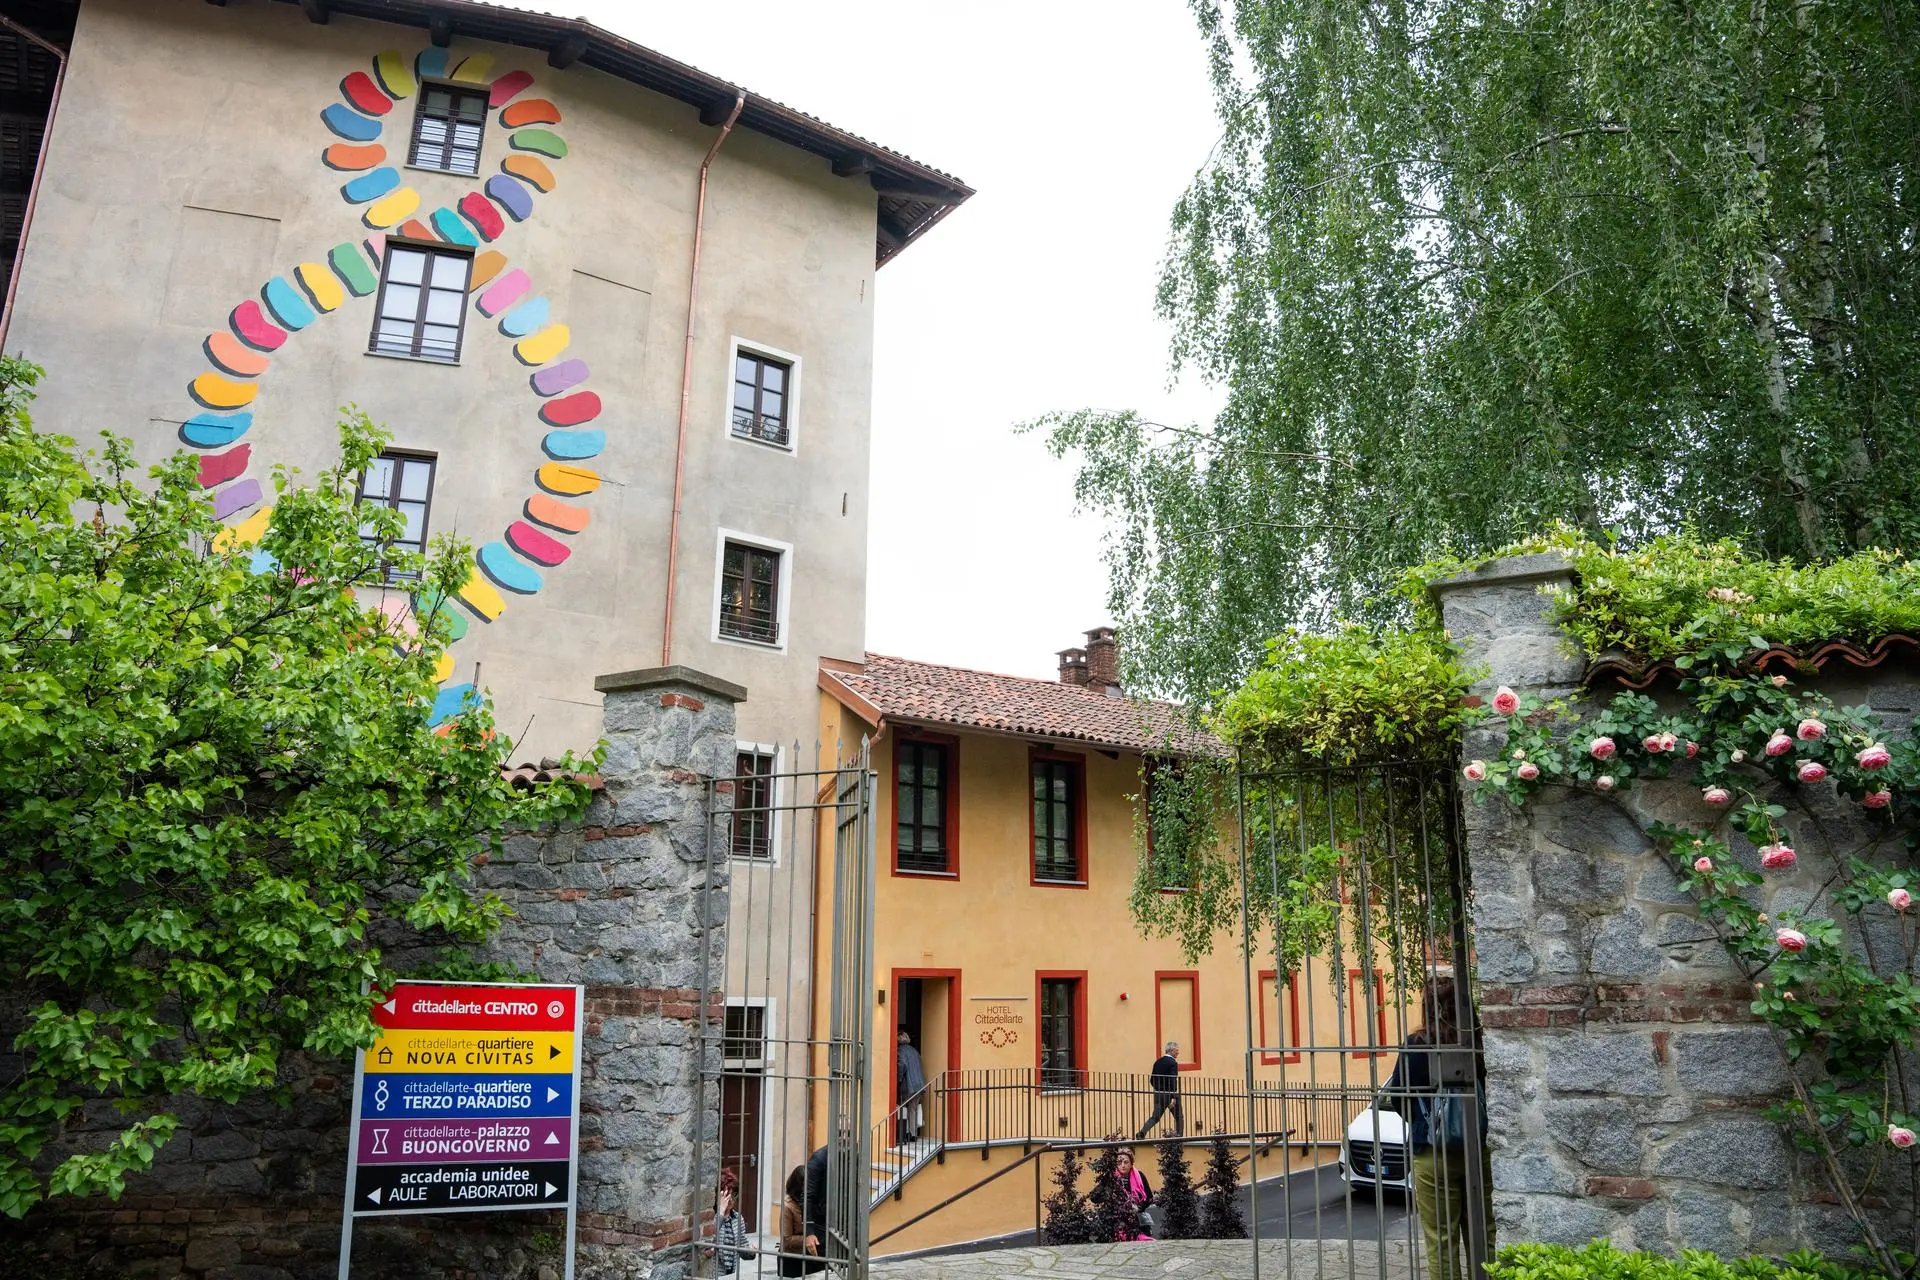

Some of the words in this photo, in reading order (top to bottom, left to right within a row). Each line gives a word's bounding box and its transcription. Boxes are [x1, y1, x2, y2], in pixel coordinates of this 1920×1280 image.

[412, 1000, 482, 1014] cittadellarte
[484, 1001, 539, 1016] CENTRO
[986, 1006, 1012, 1014] HOTEL
[975, 1014, 1023, 1024] Cittadellarte
[407, 1052, 457, 1065] NOVA
[465, 1052, 534, 1065] CIVITAS
[403, 1096, 452, 1109] TERZO
[457, 1095, 531, 1109] PARADISO
[402, 1138, 531, 1154] BUONGOVERNO
[400, 1168, 477, 1184] accademia
[482, 1166, 530, 1182] unidee
[389, 1187, 428, 1202] AULE
[449, 1183, 539, 1200] LABORATORI
